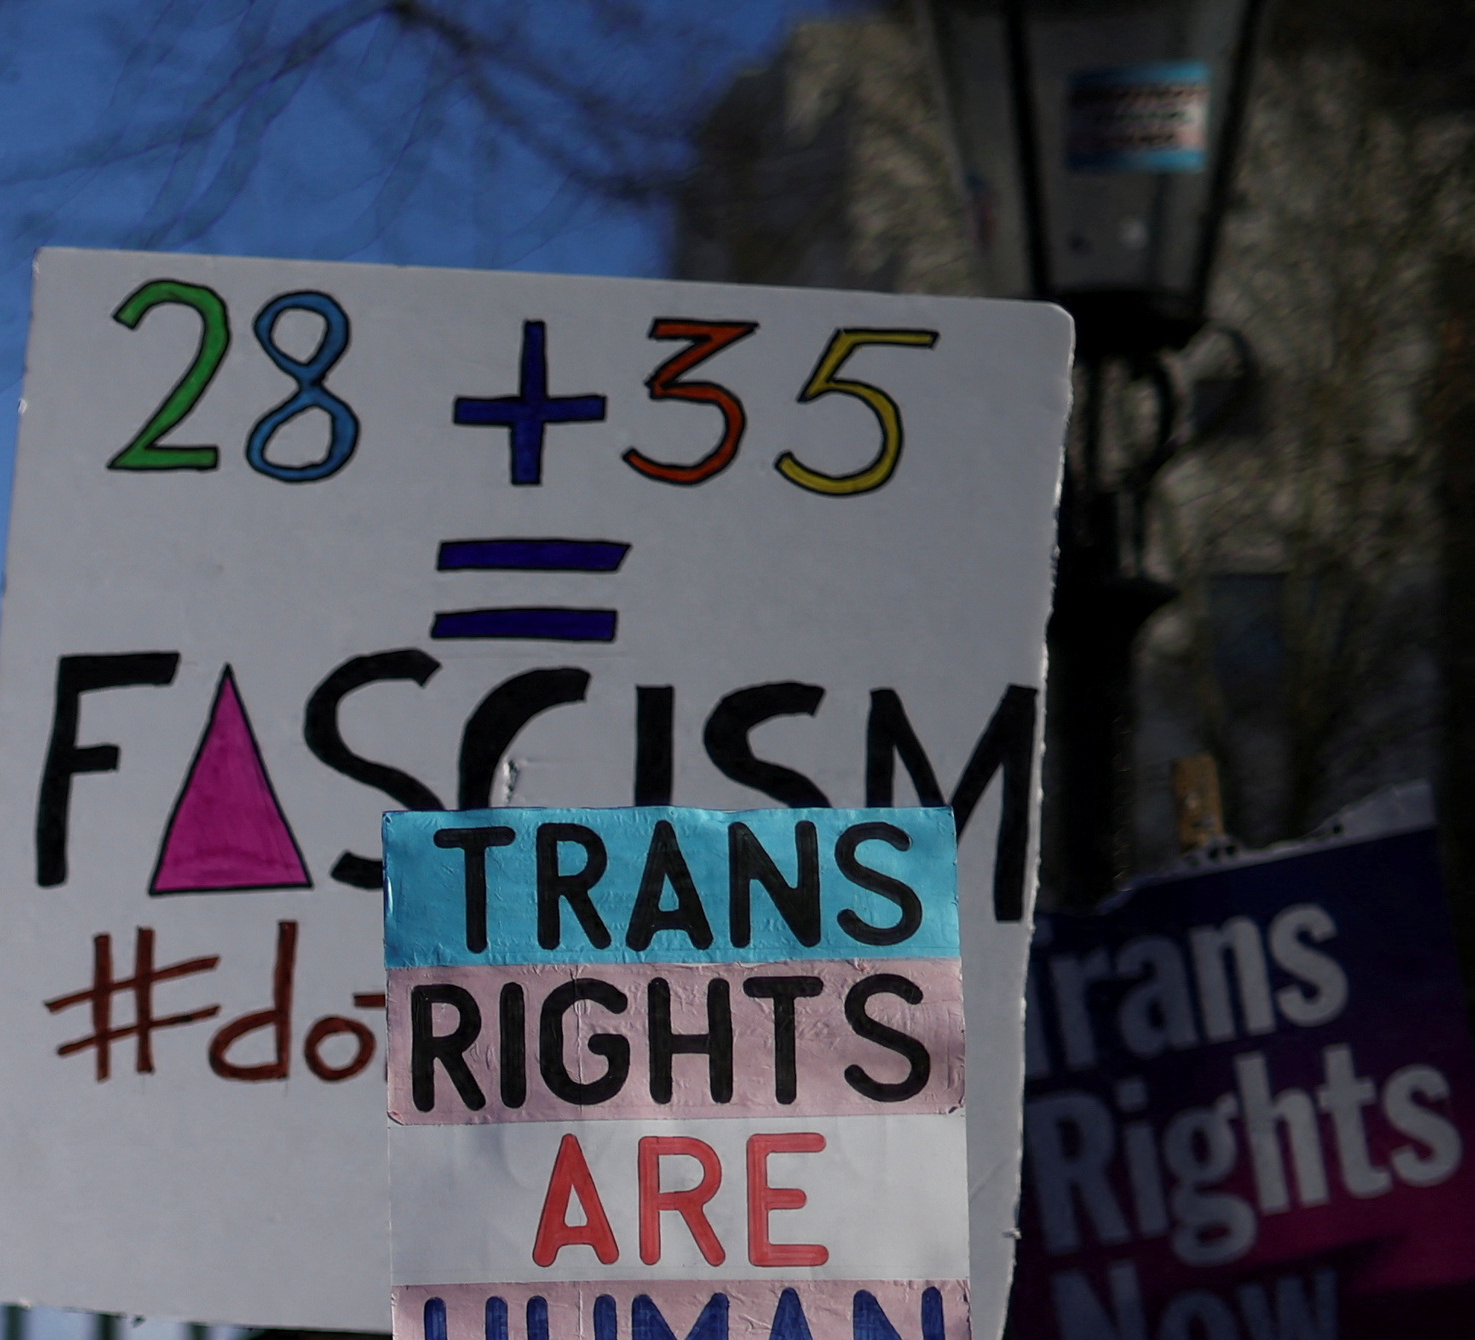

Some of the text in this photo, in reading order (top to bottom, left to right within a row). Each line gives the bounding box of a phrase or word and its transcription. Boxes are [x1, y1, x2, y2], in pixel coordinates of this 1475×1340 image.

[107, 278, 360, 482] 28
[432, 818, 924, 954] TRANS
[44, 919, 386, 1083] #do
[409, 972, 933, 1113] RIGHTS
[531, 1131, 832, 1268] ARE
[1027, 1042, 1464, 1268] Rights
